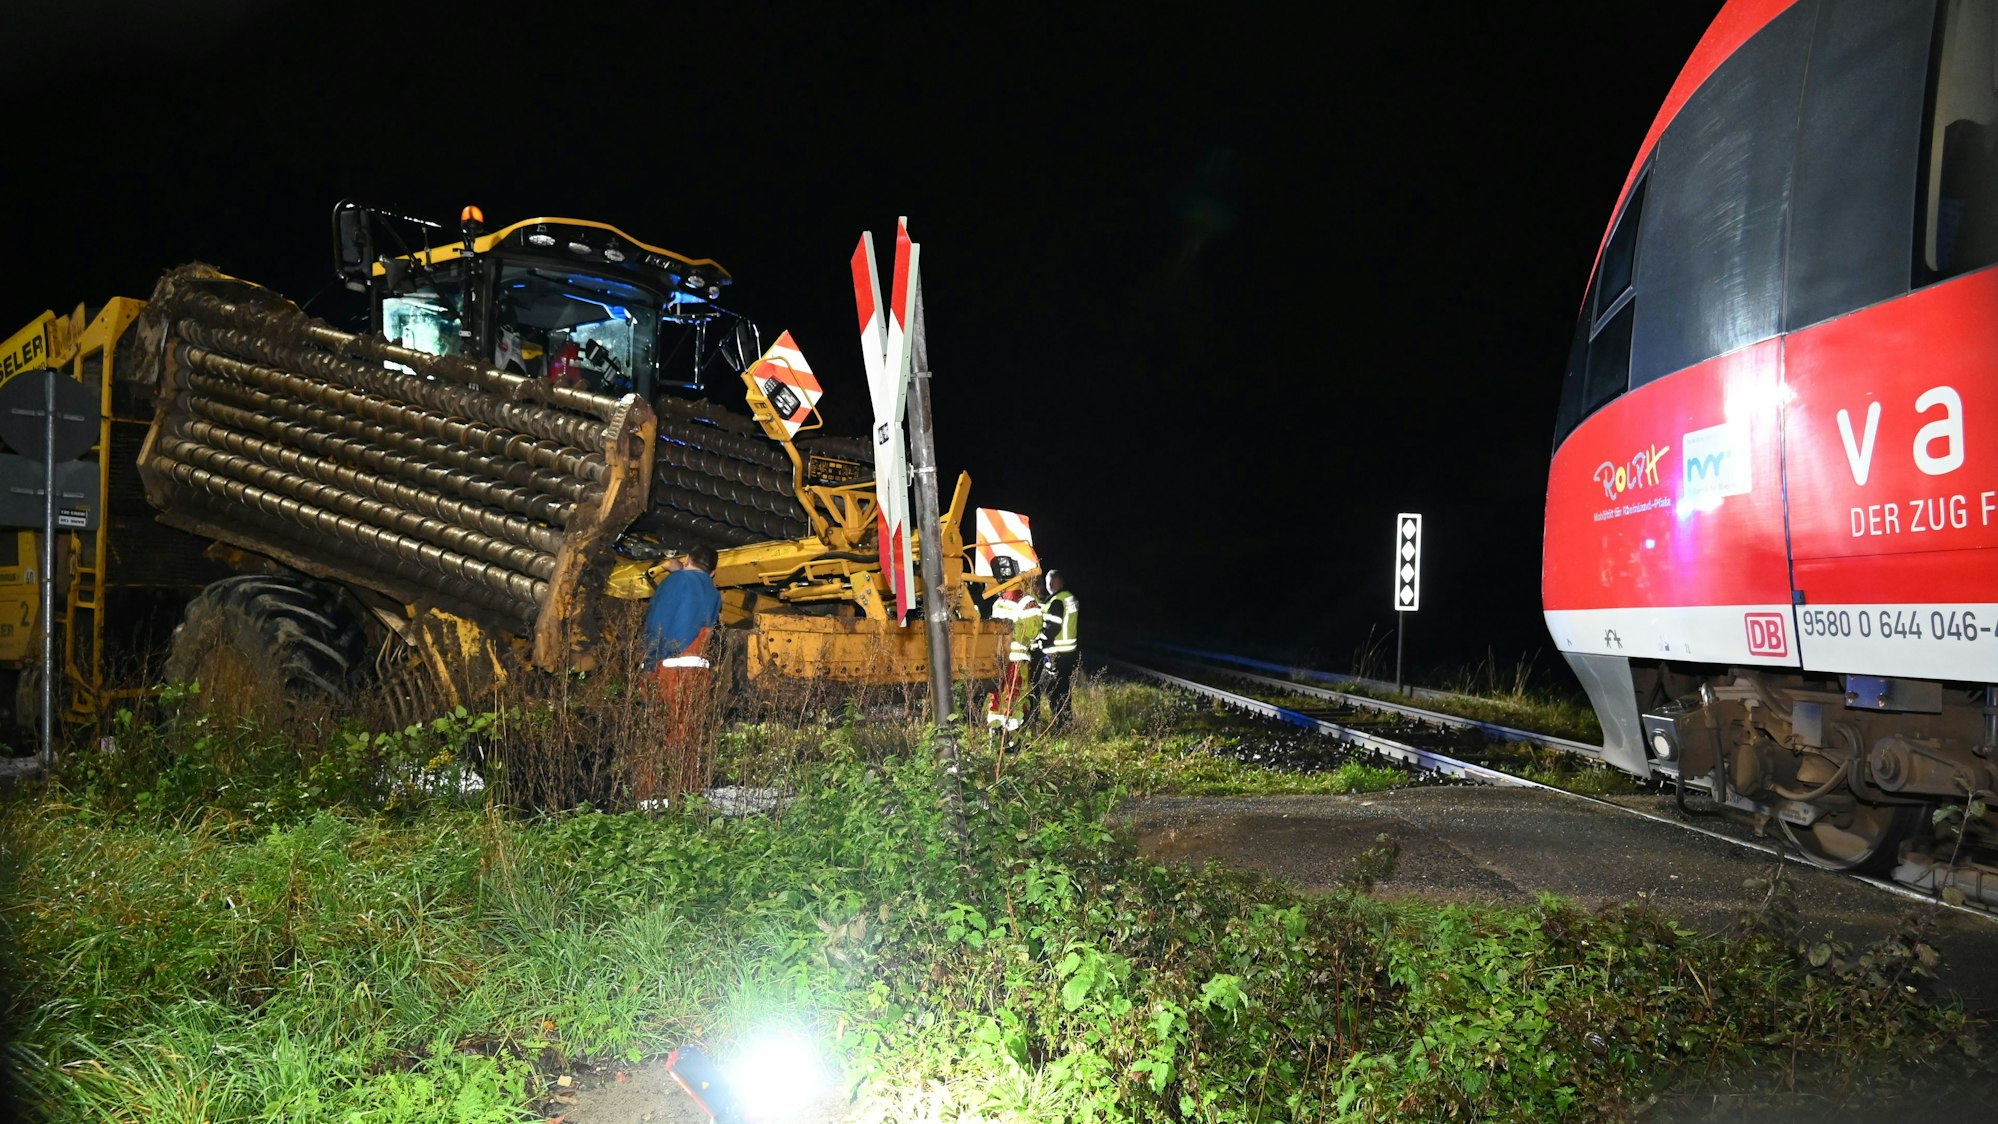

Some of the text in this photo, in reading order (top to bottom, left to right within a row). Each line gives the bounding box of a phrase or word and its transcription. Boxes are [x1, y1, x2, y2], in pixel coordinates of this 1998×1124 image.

[1593, 444, 1670, 501] ROLPH
[1850, 503, 1900, 538] DER
[1909, 494, 1968, 532] ZUG
[20, 600, 30, 627] 2
[1803, 610, 1851, 637] 9580
[1858, 610, 1872, 638] 0
[1879, 610, 1922, 640] 644
[1750, 619, 1782, 650] DB
